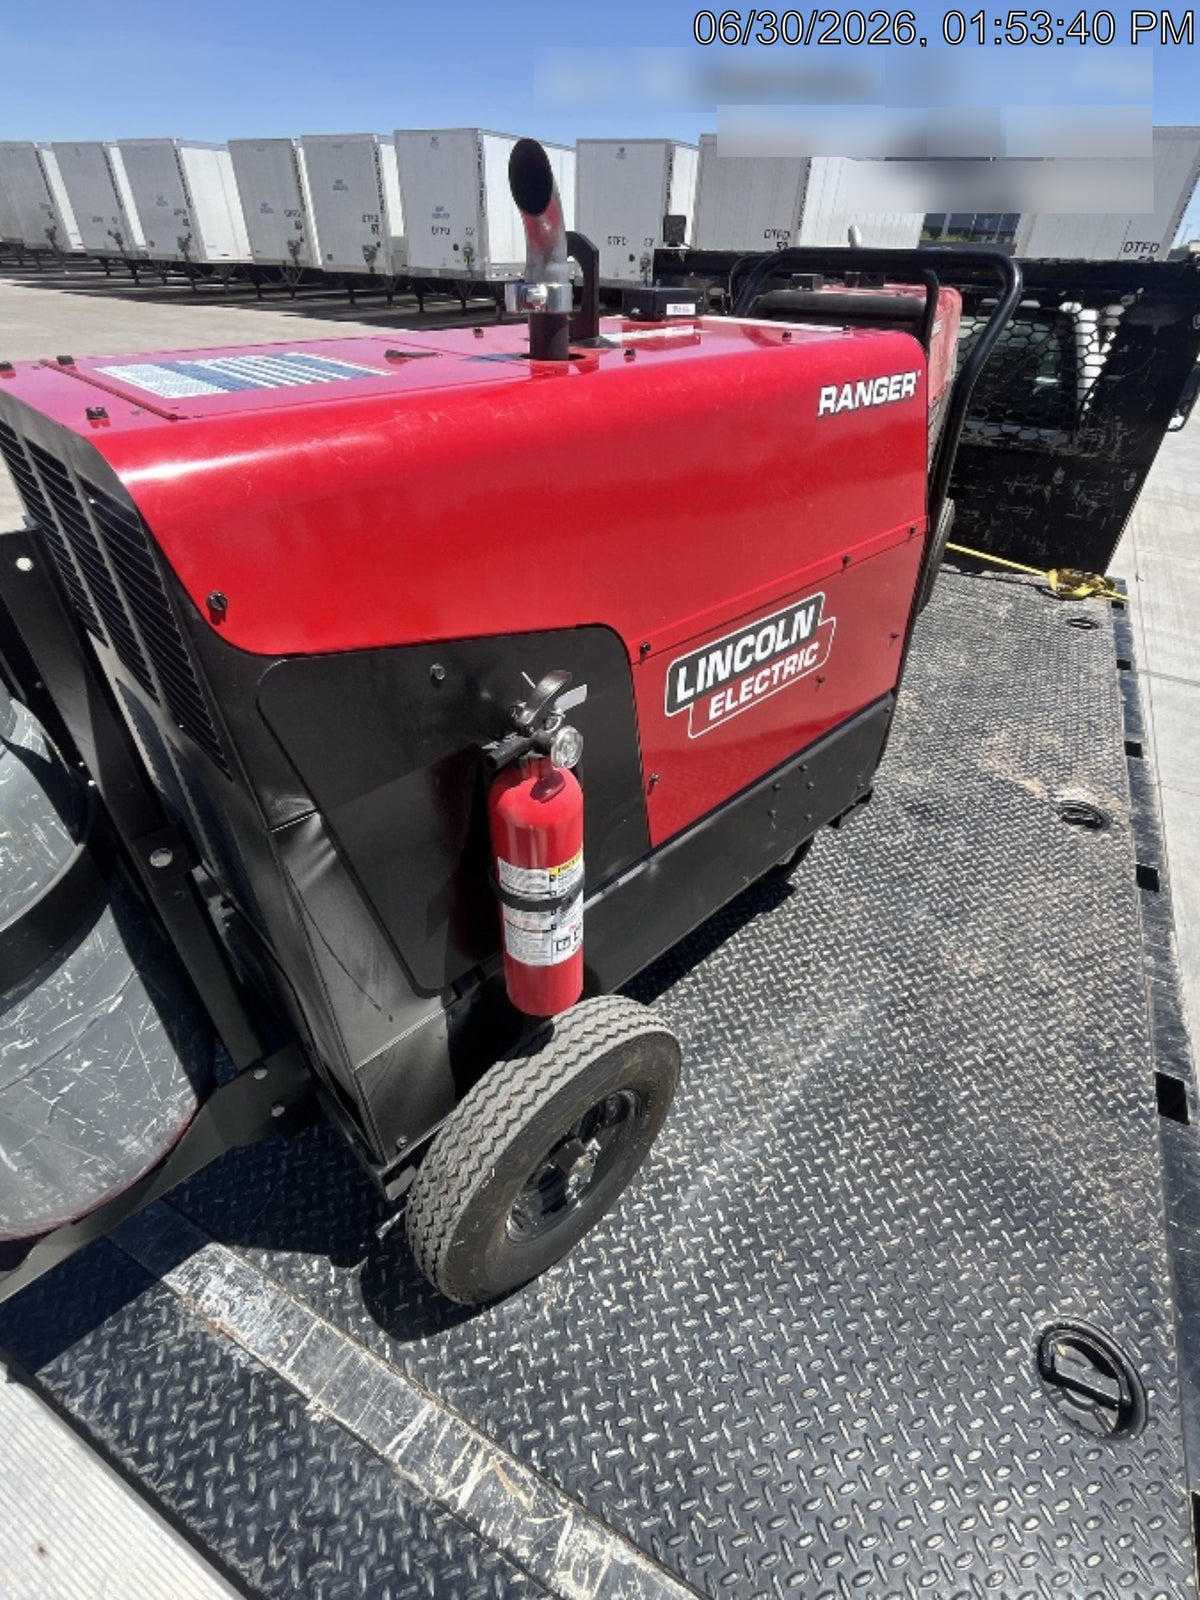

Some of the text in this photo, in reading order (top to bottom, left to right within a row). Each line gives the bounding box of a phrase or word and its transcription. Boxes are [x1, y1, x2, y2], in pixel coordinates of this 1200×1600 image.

[1123, 241, 1160, 254] DTFD
[817, 371, 918, 417] RANGER
[676, 604, 815, 703] LINCOLN
[709, 641, 820, 721] ELECTRIC
